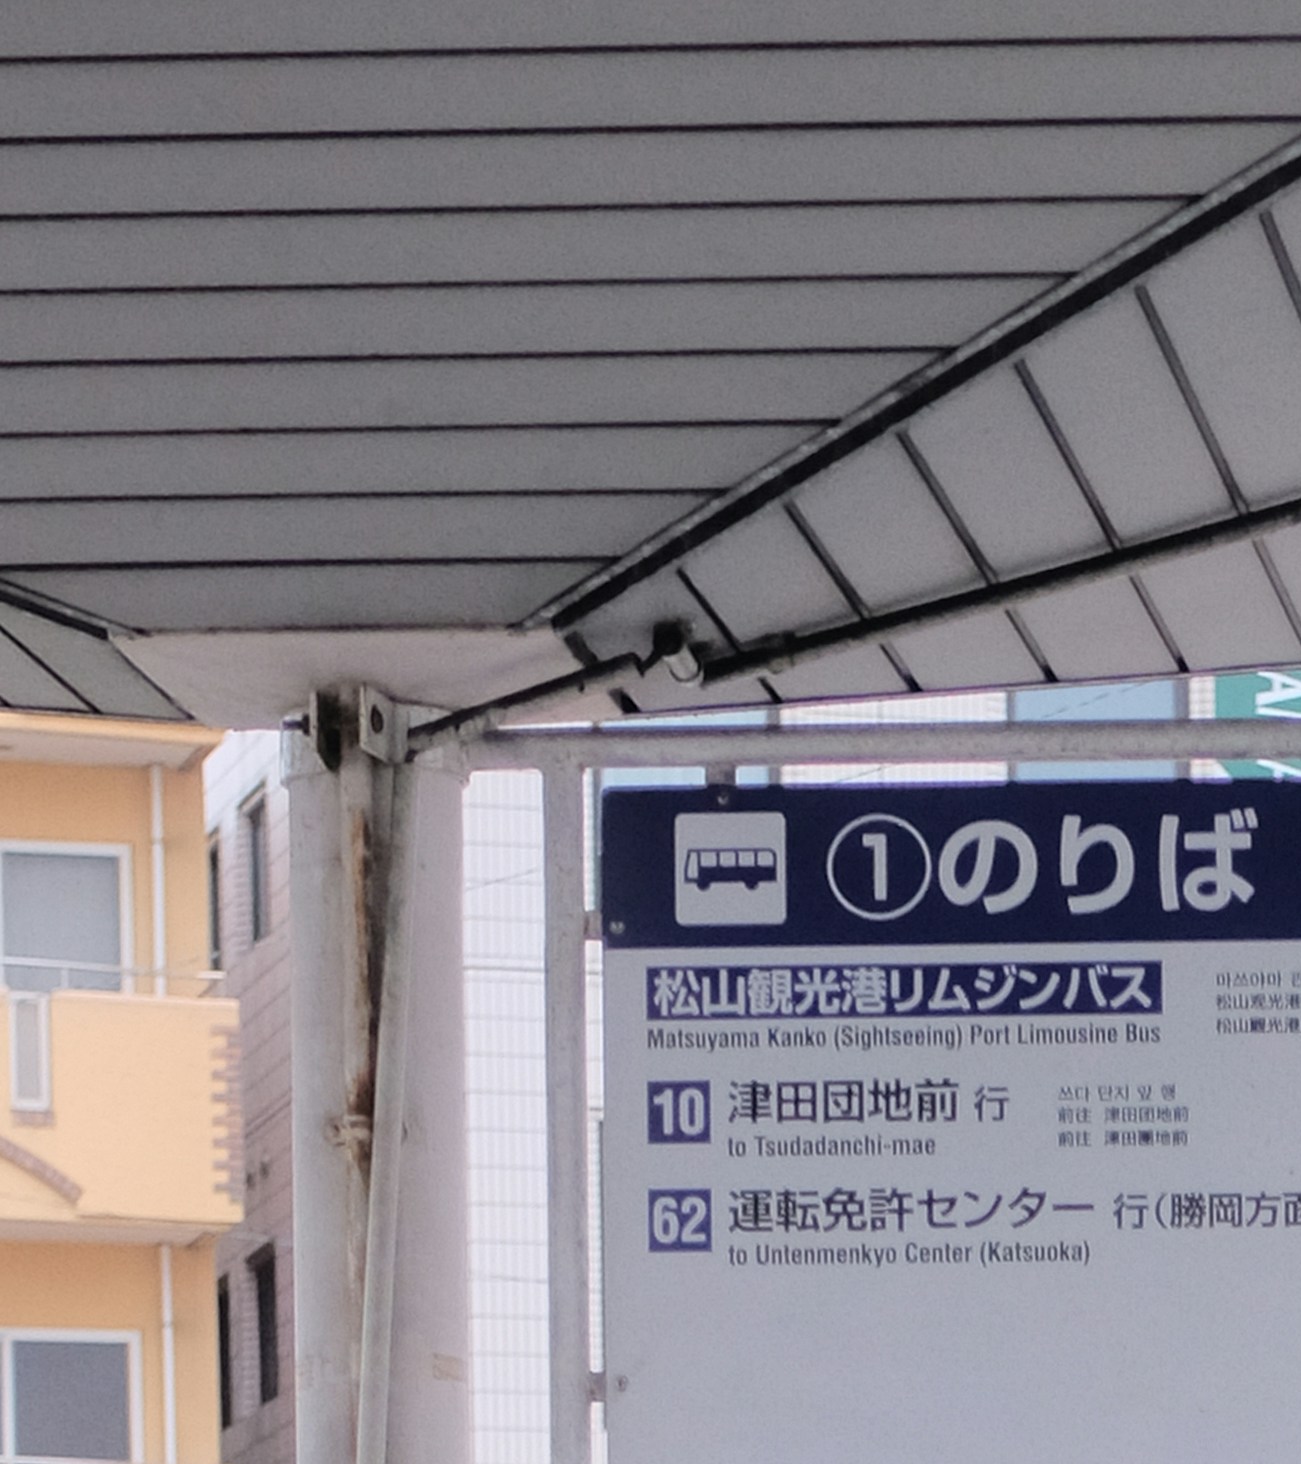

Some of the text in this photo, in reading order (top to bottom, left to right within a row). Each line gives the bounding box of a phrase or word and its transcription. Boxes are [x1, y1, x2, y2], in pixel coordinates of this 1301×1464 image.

[653, 964, 1152, 1017] 松山観光港リムジンバス
[647, 1021, 1161, 1052] Matsuyama Kanko (Sightseeing) Port Limousine Bus
[652, 1087, 705, 1137] 10
[728, 1078, 1010, 1124] 津田団地前 行
[728, 1134, 936, 1158] to Tsudadanchi-mae
[652, 1196, 708, 1244] 62
[728, 1186, 1095, 1233] 運転免許センター
[729, 1240, 1090, 1269] to Untenmenkyo Center (Katsuoka)
